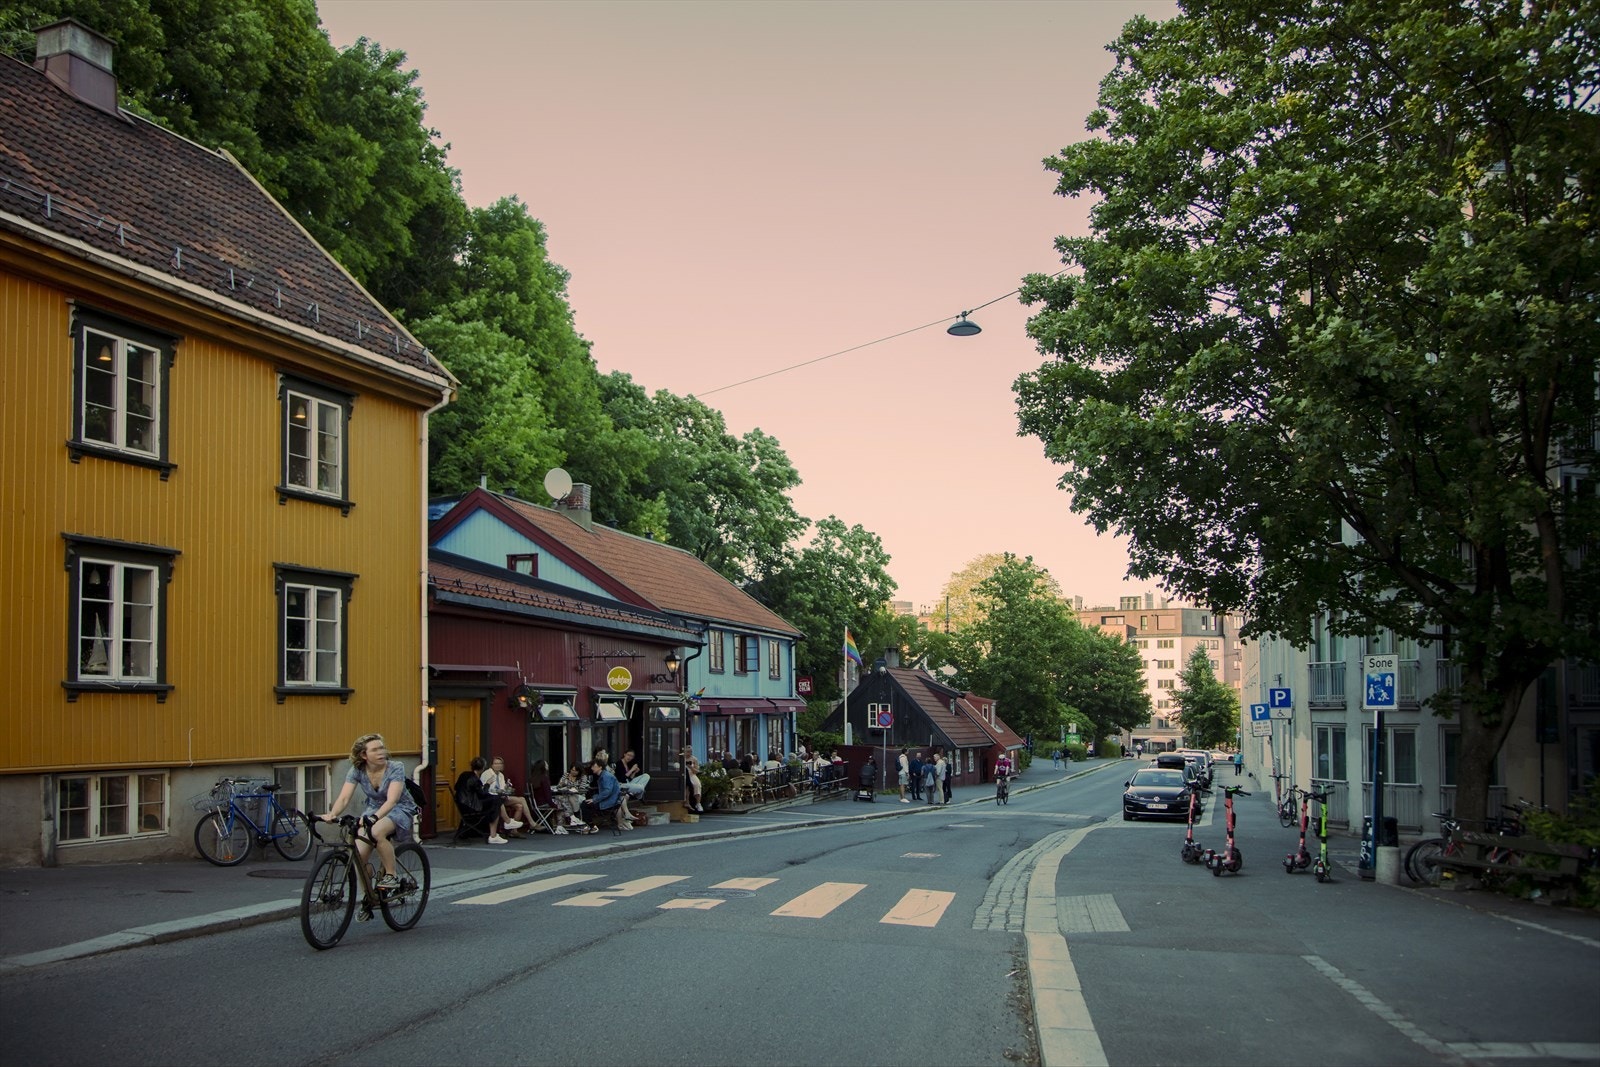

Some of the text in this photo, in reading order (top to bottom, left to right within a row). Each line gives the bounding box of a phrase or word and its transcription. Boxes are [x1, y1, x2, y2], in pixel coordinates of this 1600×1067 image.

[1369, 658, 1393, 668] Sone
[1275, 690, 1286, 706] P
[1255, 705, 1265, 719] P
